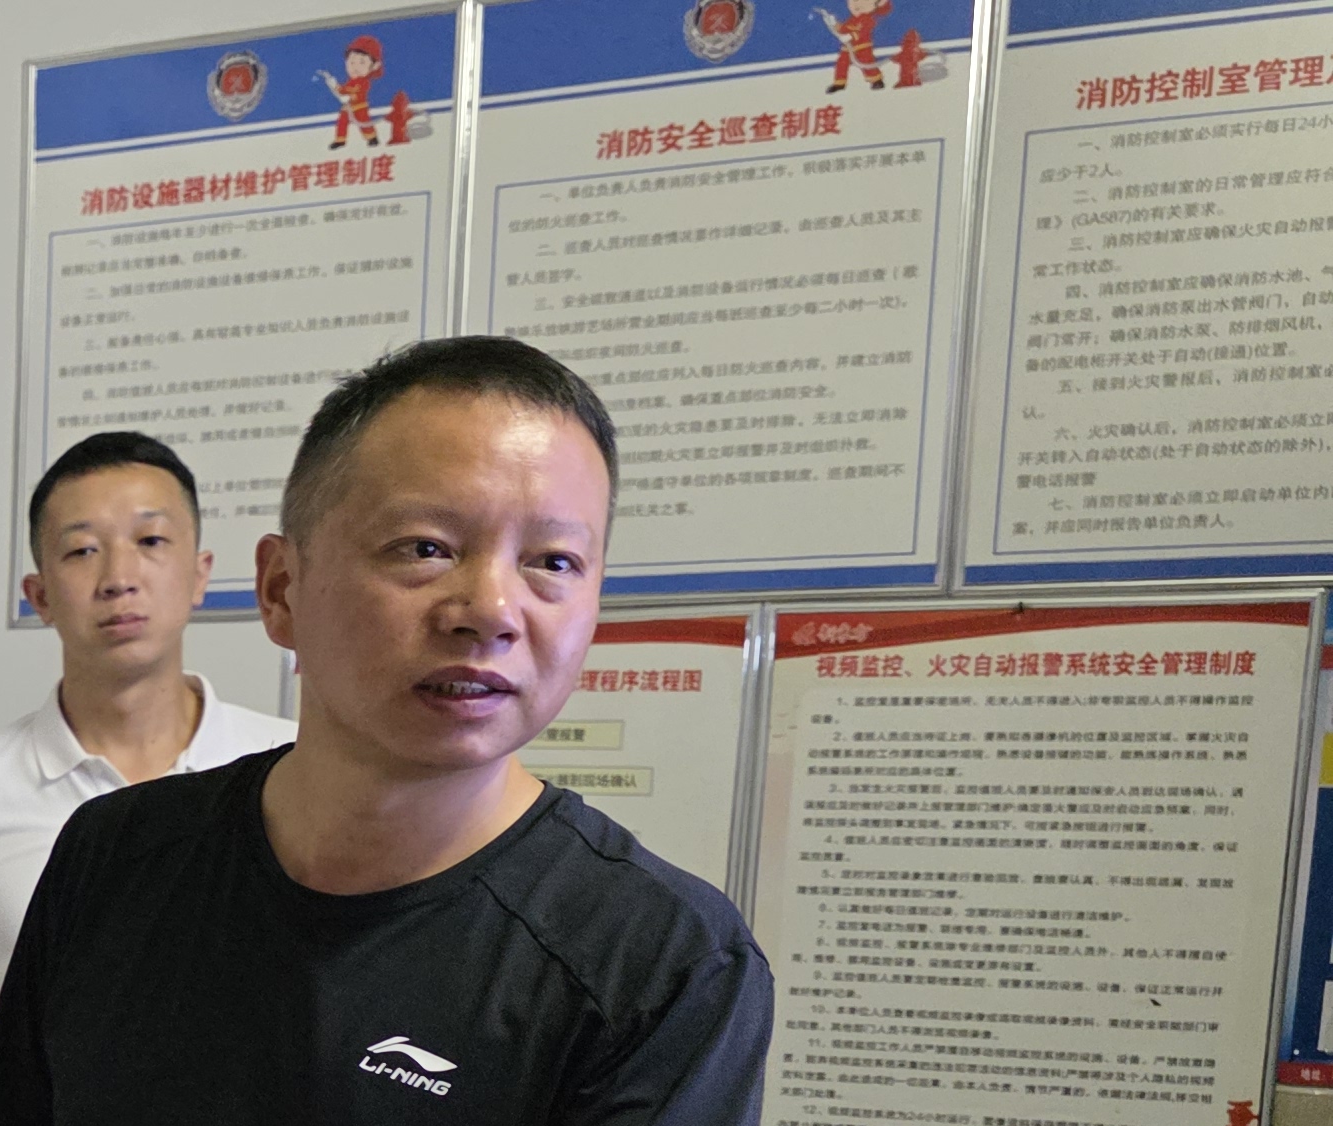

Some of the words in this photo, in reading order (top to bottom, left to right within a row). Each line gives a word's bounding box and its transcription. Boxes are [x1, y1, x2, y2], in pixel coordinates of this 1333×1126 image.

[1076, 54, 1333, 110] 消防控制室管理
[595, 103, 844, 160] 消防安全巡查制度
[80, 153, 397, 217] 消防设施器材维护管理制度
[359, 1055, 452, 1096] LI-NING
